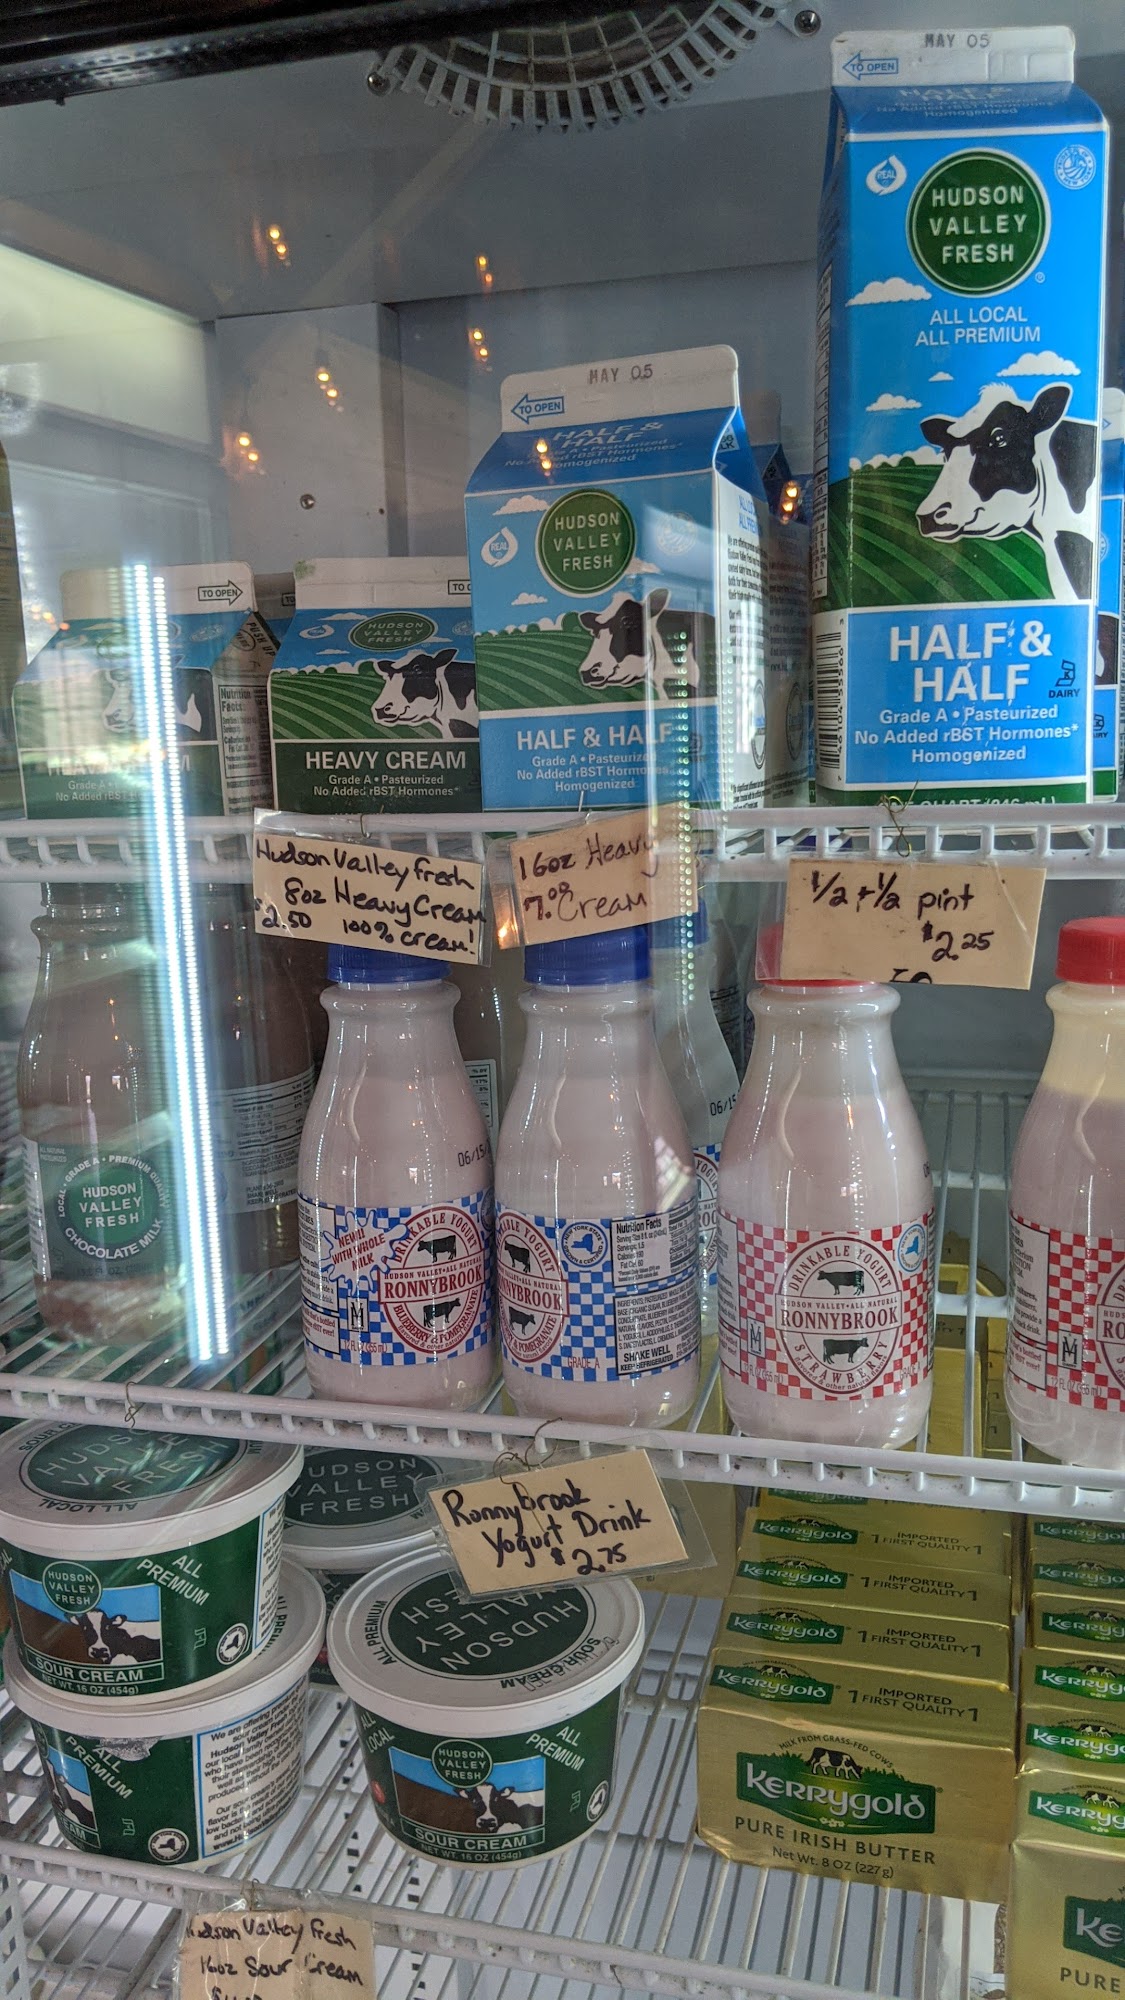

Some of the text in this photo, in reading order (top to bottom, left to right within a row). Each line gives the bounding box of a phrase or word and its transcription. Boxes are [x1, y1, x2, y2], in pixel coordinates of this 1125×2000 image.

[924, 33, 991, 49] MAY 05
[850, 61, 895, 73] TO OPEN
[931, 185, 1025, 208] HUDSON
[929, 213, 1028, 237] VALLEY
[941, 243, 1015, 265] FRESH
[929, 306, 1028, 325] ALL LOCAL
[915, 326, 1041, 347] ALL PREMIUM
[588, 363, 654, 385] MAY 05
[518, 401, 561, 415] TO OPEN
[554, 512, 620, 531] HUDSON
[552, 532, 623, 552] VALLEY
[562, 555, 613, 572] FRESH
[202, 588, 239, 598] TO OPEN
[363, 628, 422, 637] VALLEY
[367, 621, 423, 630] HUDSON
[367, 635, 412, 644] FRESH
[889, 620, 1053, 661] HALF &
[913, 664, 1030, 702] HALF
[1047, 688, 1081, 700] DAIRY
[879, 703, 1058, 725] Grade A Pasteurized
[517, 722, 673, 750] HALF & HALF
[855, 730, 879, 745] No
[883, 728, 938, 744] Added
[942, 727, 984, 743] rBST
[305, 750, 466, 769] HEAVY CREAM
[911, 745, 1027, 764] Homogenized
[313, 786, 329, 796] No
[331, 786, 366, 796] Added
[369, 786, 396, 796] rBST
[328, 774, 444, 785] Grade A Pasteurized
[554, 778, 635, 793] Homogenized
[255, 839, 330, 867] Hudson
[333, 848, 410, 893] Valley
[518, 832, 659, 881] 16oz Heavy
[284, 876, 487, 928] 8oz Heavy Cream
[557, 890, 648, 922] Cream
[917, 883, 975, 921] pint
[342, 919, 395, 945] 100%
[82, 1182, 137, 1198] HUDSON
[79, 1196, 142, 1214] VALLEY
[85, 1213, 140, 1228] FRESH
[645, 1218, 662, 1231] Facts
[65, 1218, 163, 1260] CHOCOLATE MILK
[397, 1212, 478, 1262] DRINKABLE YOGURT
[332, 1233, 386, 1265] WITH WHOLE
[524, 1226, 556, 1272] YOGURT
[351, 1252, 375, 1272] MILK
[788, 1244, 851, 1292] DRINKABLE
[856, 1249, 892, 1289] YOGURT
[383, 1264, 483, 1299] RONNYBROOK
[392, 1289, 479, 1343] BLUEBERRY POMEGRANATE
[781, 1306, 898, 1331] RONNYBROOK
[623, 1344, 671, 1363] SHAKE WELL
[794, 1340, 888, 1385] STRAWBERRY
[111, 1440, 230, 1495] FRESH
[287, 1473, 423, 1498] VALLEY
[300, 1493, 409, 1516] FRESH
[481, 1498, 652, 1569] Yogurt Drink
[48, 1571, 93, 1583] HUDSON
[136, 1554, 210, 1606] ALL PREMIUM
[743, 1563, 842, 1588] Kerrygold
[888, 1574, 954, 1589] IMPORTED
[48, 1581, 96, 1594] VALLEY
[55, 1593, 91, 1606] FRESH
[440, 1600, 581, 1671] HUDSON
[733, 1616, 838, 1642] Kerrygold
[886, 1628, 956, 1643] IMPORTED
[35, 1658, 144, 1683] SOUR CREAM
[42, 1673, 140, 1696] NET WT. 16 OZ (454g)
[717, 1668, 827, 1698] Kerrygold
[862, 1693, 897, 1707] FIRST
[902, 1700, 965, 1718] QUALITY
[879, 1687, 952, 1706] IMPORTED
[361, 1712, 396, 1754] ALL LOCAL
[555, 1725, 581, 1748] ALL
[438, 1748, 485, 1760] HUDSON
[525, 1732, 586, 1771] PREMIUM
[779, 1733, 894, 1769] MILK FROM GRASS-FED COWS
[65, 1736, 134, 1800] ALL PREMIUM
[439, 1759, 487, 1770] VALLEY
[444, 1769, 481, 1780] FRESH
[745, 1762, 926, 1820] Kerrygold
[414, 1827, 527, 1850] SOUR CREAM
[734, 1816, 936, 1865] PURE IRISH BUTTER
[772, 1845, 895, 1879] Net Wt. 8 OZ (227 g)
[244, 1956, 293, 1978] Sour
[1059, 1966, 1121, 1994] PURE
